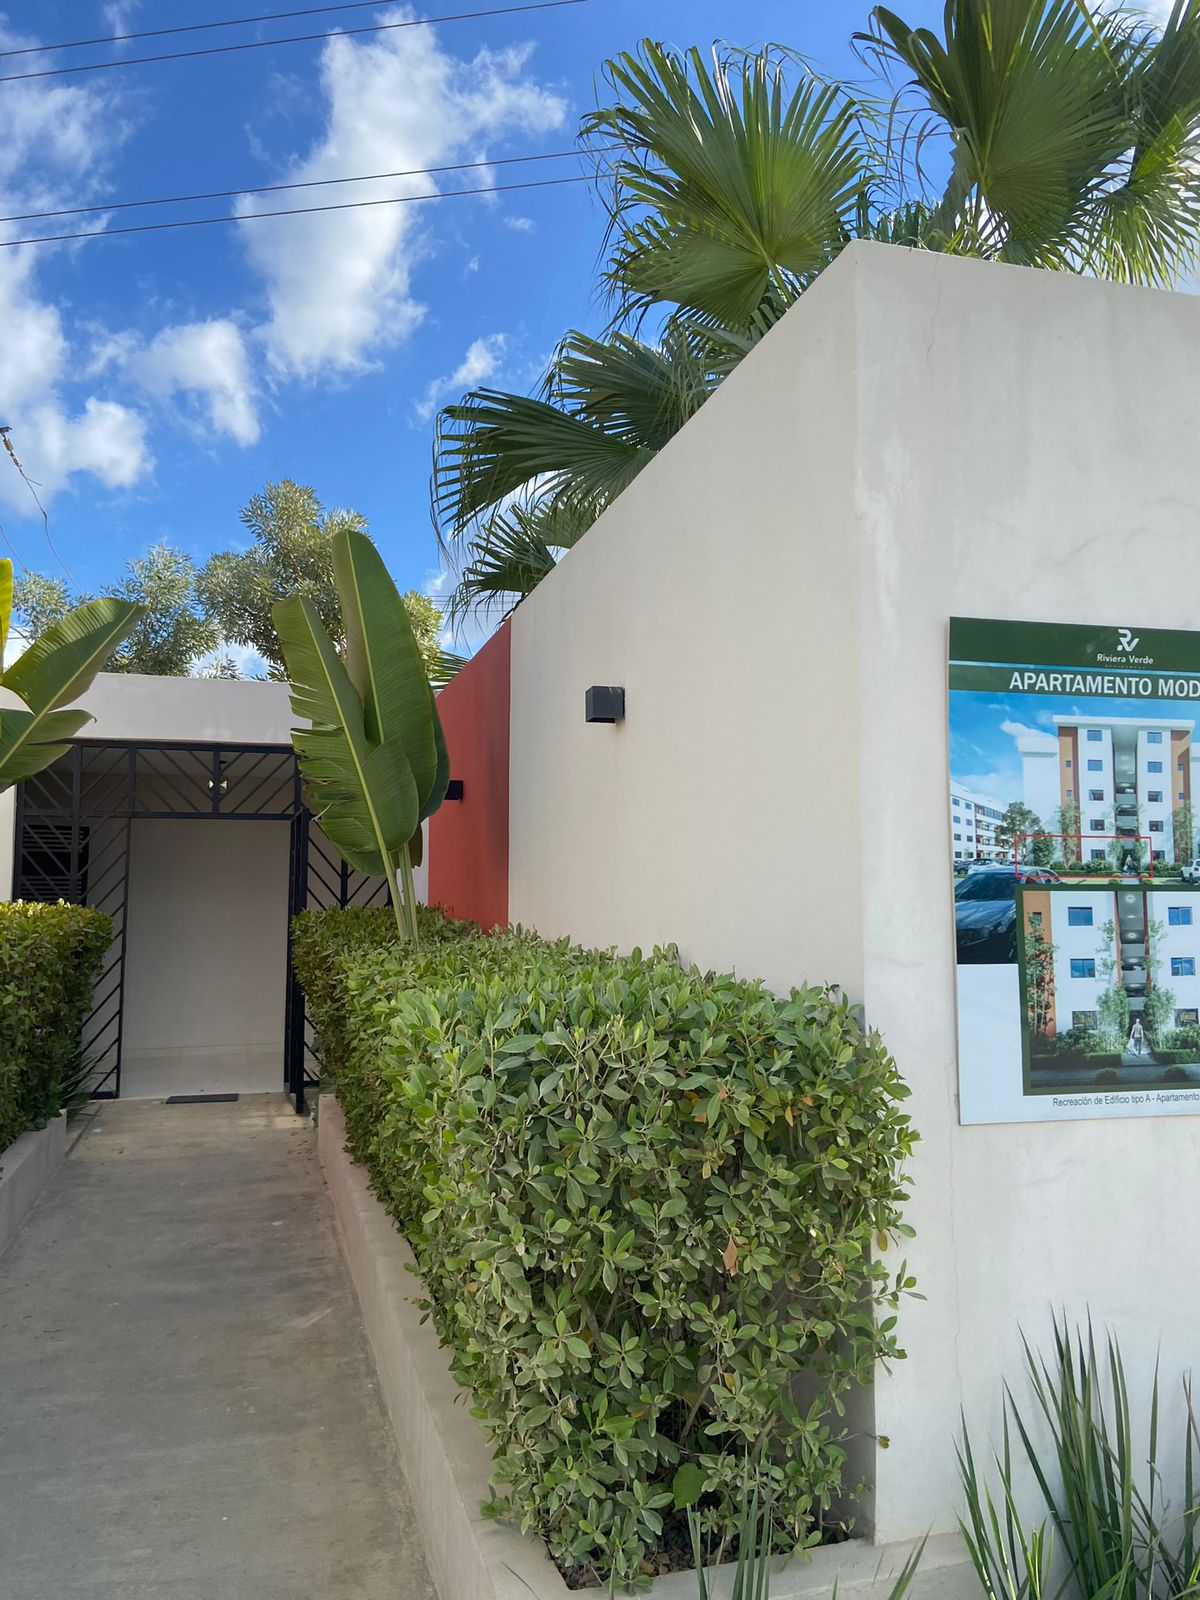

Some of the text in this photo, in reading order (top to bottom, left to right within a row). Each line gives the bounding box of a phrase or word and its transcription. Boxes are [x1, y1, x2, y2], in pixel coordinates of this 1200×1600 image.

[1097, 653, 1154, 665] Riviera Verde
[1009, 672, 1200, 697] APARTAMENTO MOD
[1053, 1097, 1093, 1107] Recreación
[1094, 1096, 1103, 1105] de
[1105, 1095, 1130, 1104] Edificio
[1131, 1095, 1145, 1105] tipo
[1145, 1094, 1151, 1103] A
[1156, 1092, 1200, 1104] Apartamento
